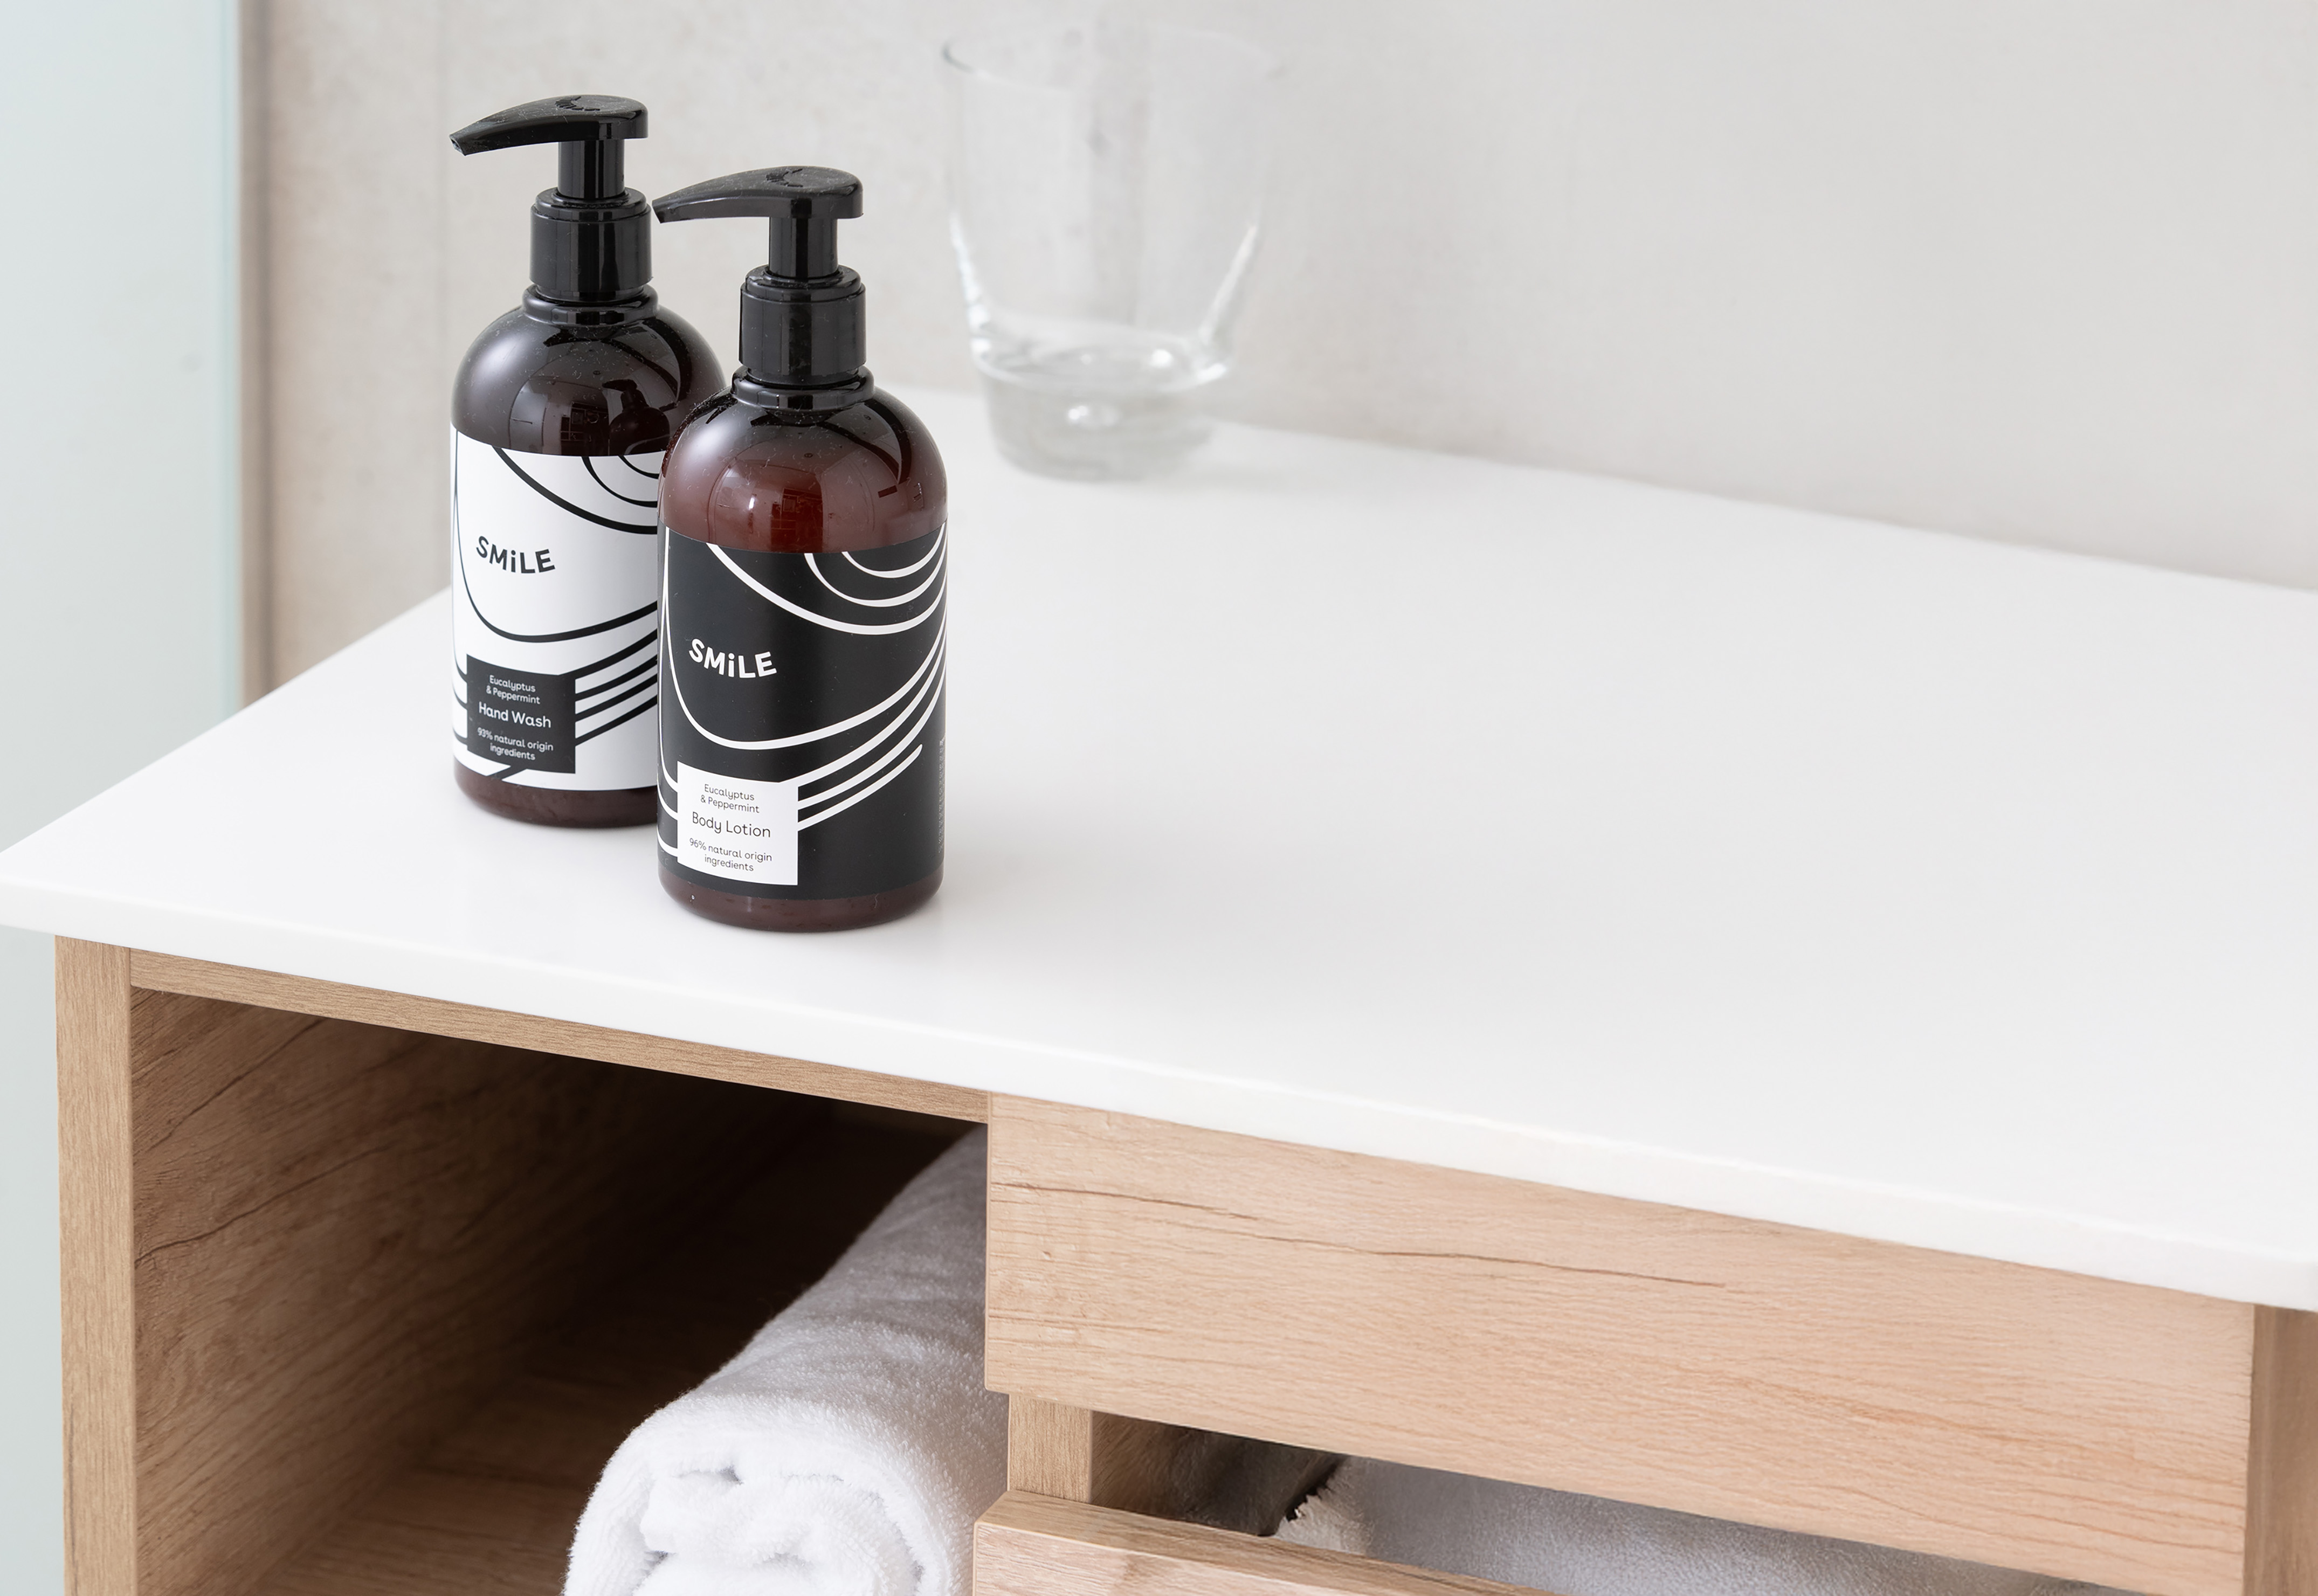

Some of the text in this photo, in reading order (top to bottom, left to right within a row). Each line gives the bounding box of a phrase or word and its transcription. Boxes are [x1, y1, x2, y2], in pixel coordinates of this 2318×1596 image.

[489, 674, 536, 693] Eucalyptus
[486, 685, 541, 704] & Peppermint
[478, 701, 551, 728] Hand Wash
[477, 727, 554, 752] 93% natural origin
[489, 742, 536, 761] ingredients
[704, 784, 755, 801] Eucalyptus
[700, 794, 760, 813] & Peppermint
[692, 811, 771, 838] Body Lotion
[689, 838, 772, 863] 96% natural origin
[704, 854, 754, 872] ingredients
